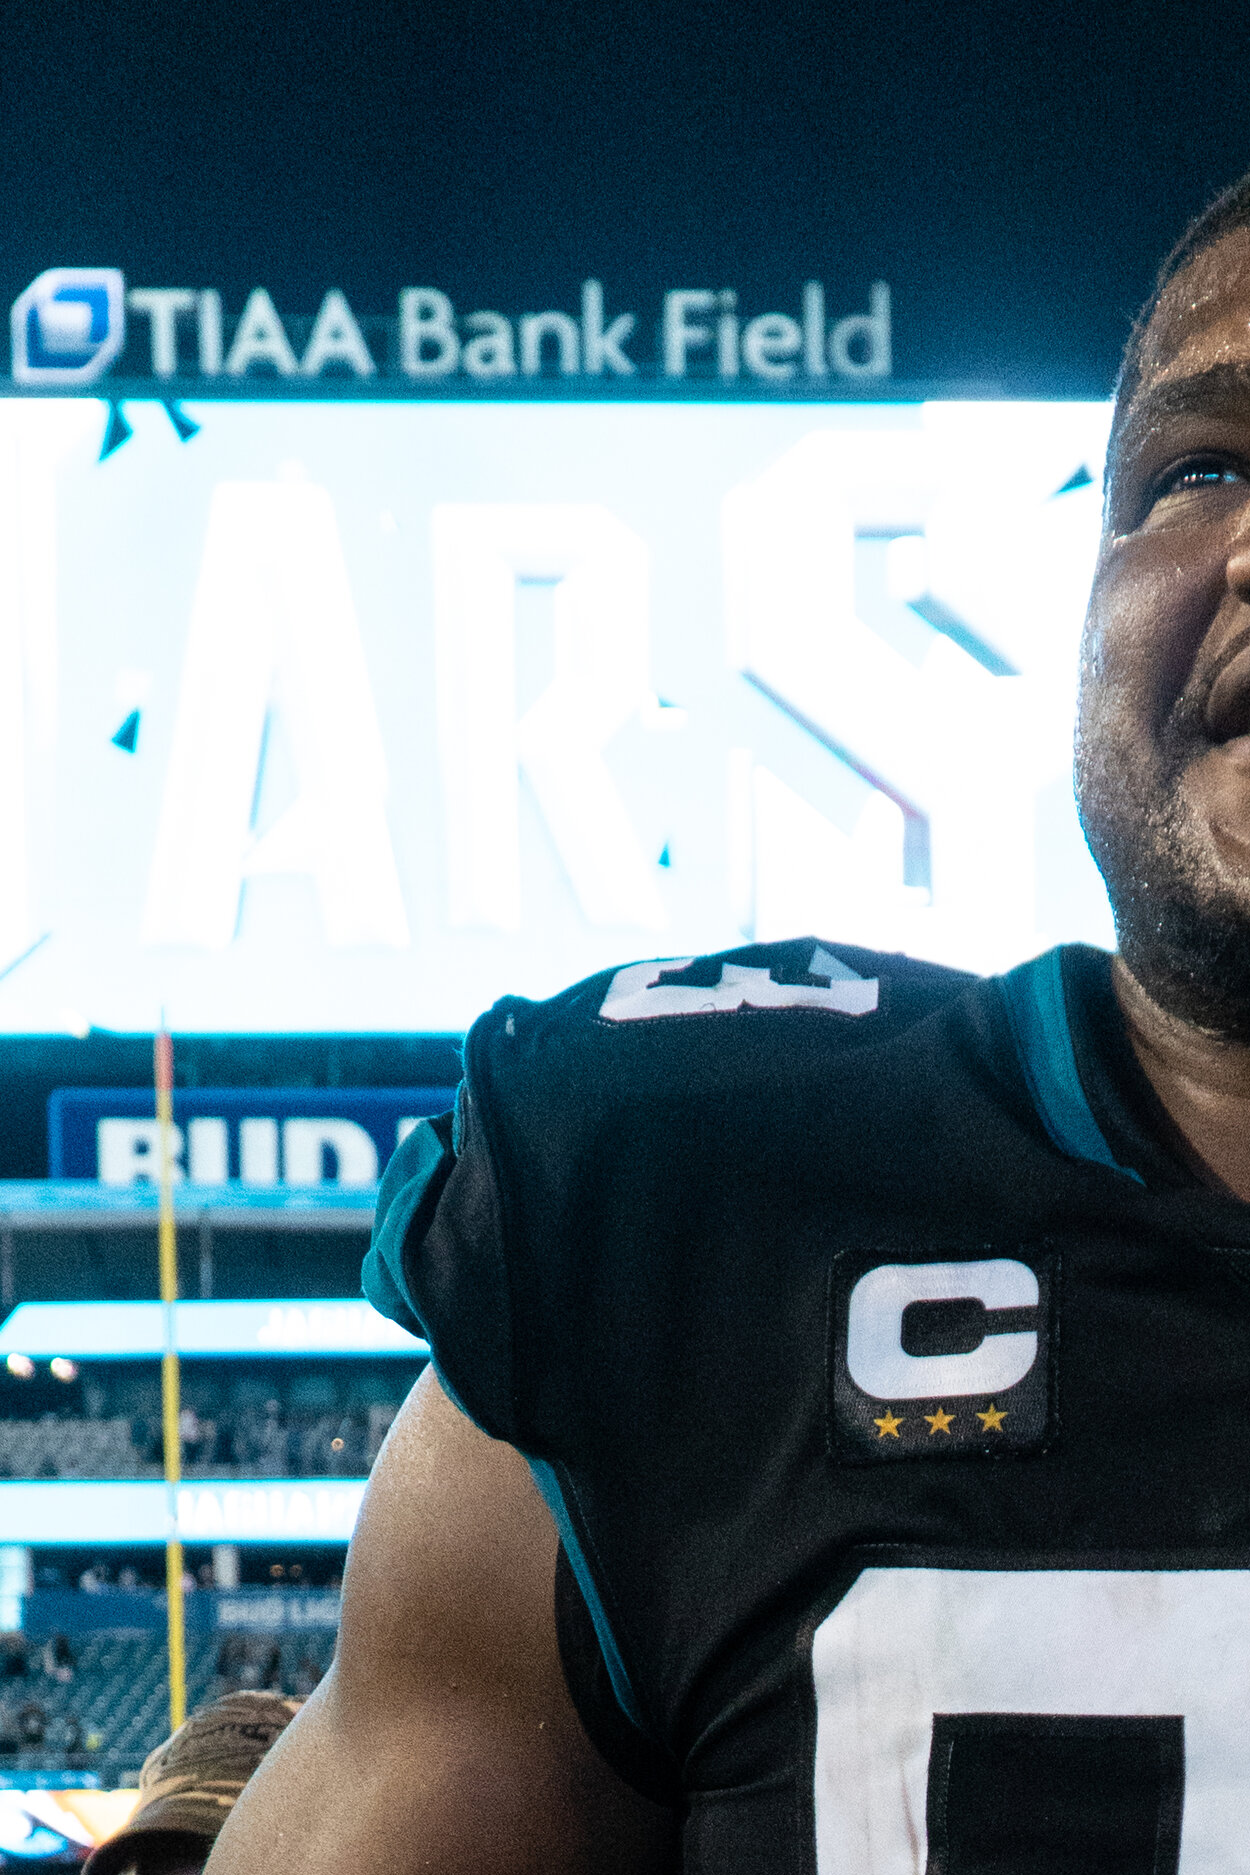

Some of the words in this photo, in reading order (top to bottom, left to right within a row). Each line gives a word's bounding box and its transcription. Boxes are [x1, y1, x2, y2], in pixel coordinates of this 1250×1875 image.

[128, 288, 376, 377] TIAA
[400, 278, 637, 378] Bank
[662, 277, 892, 378] Field
[847, 1258, 1039, 1400] C
